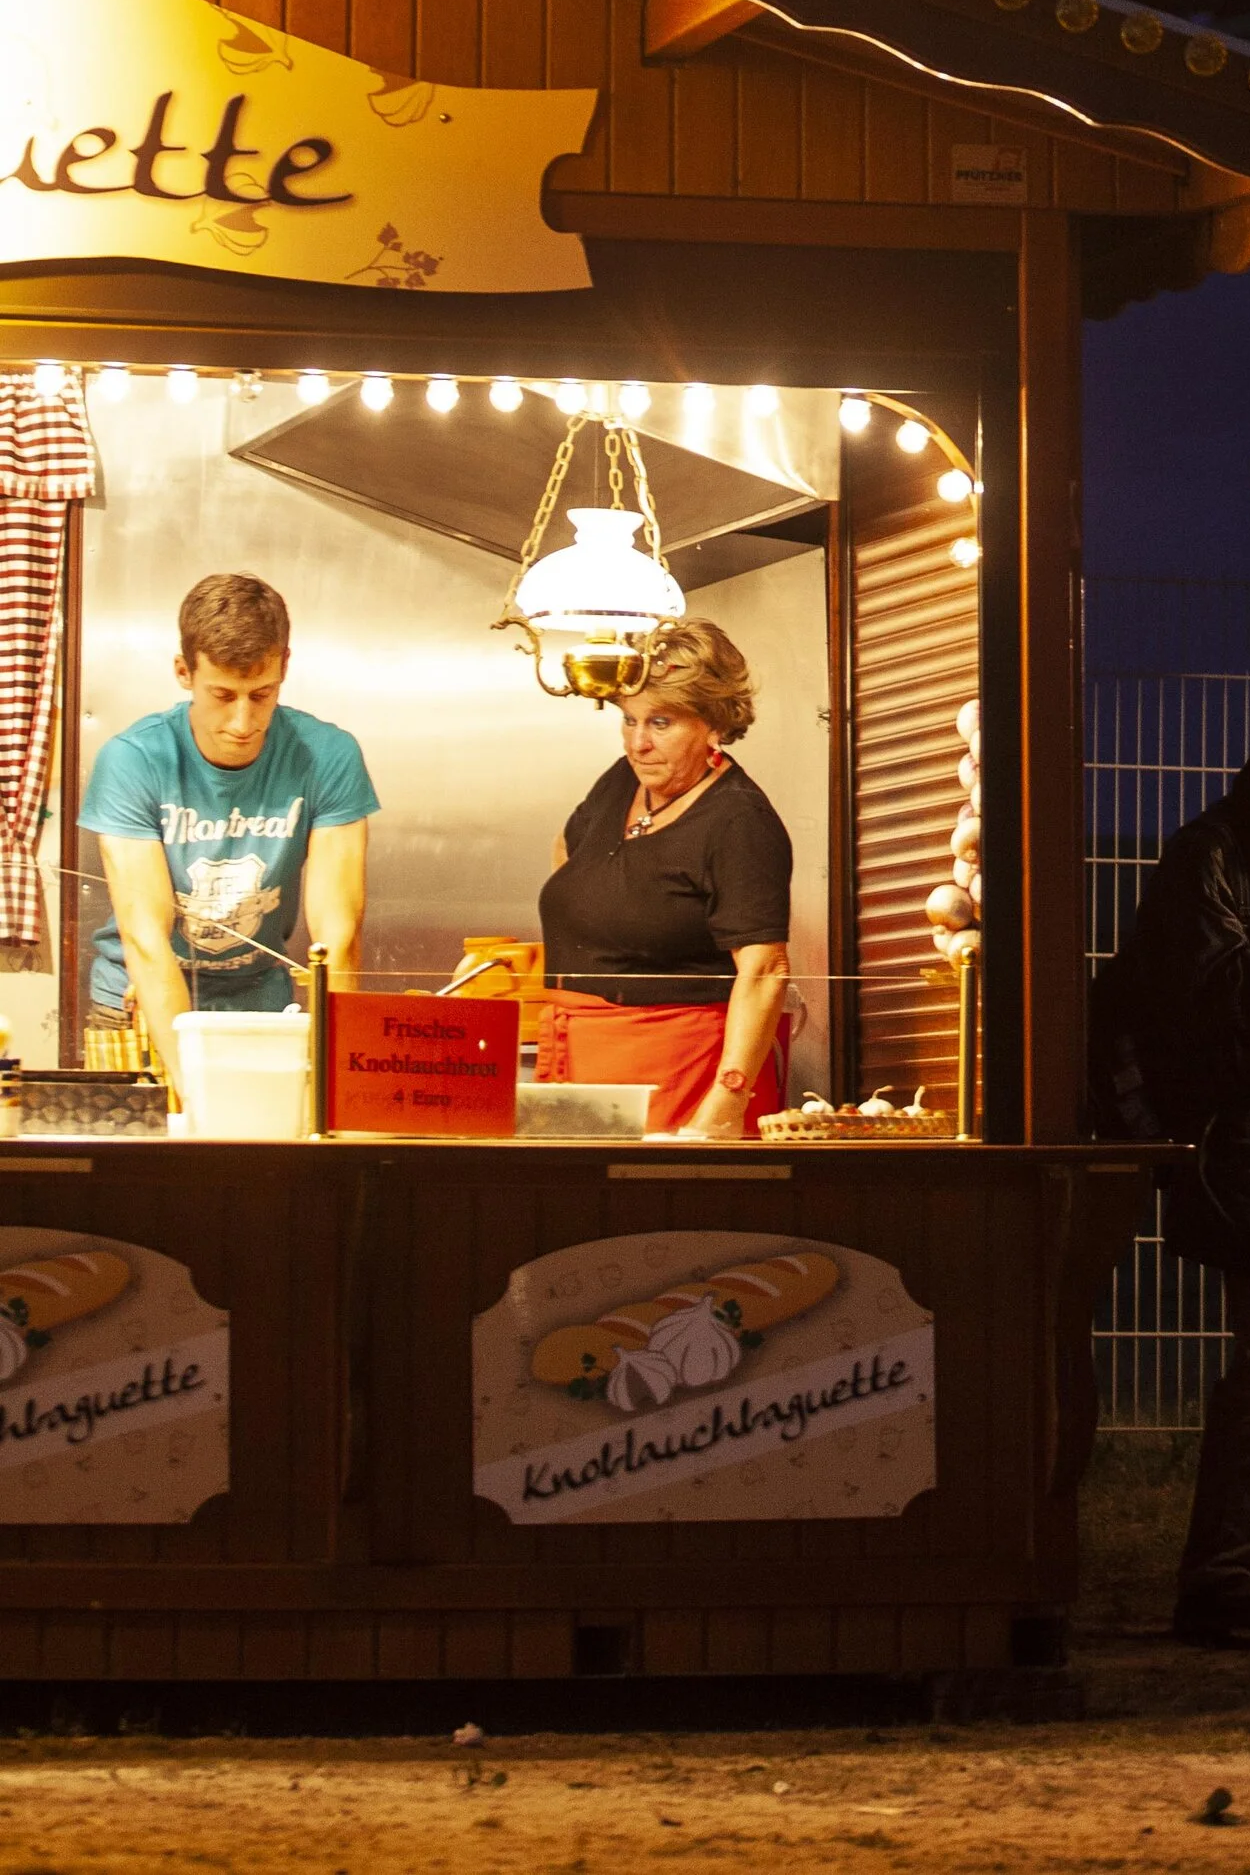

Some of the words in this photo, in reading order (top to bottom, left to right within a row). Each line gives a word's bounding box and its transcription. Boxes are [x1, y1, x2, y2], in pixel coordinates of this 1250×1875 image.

[160, 796, 305, 845] Montreal
[382, 1016, 466, 1040] Frisches
[348, 1051, 498, 1078] Knoblauchbrot
[412, 1089, 452, 1107] Euro
[521, 1353, 913, 1503] Knoblauchbaguette
